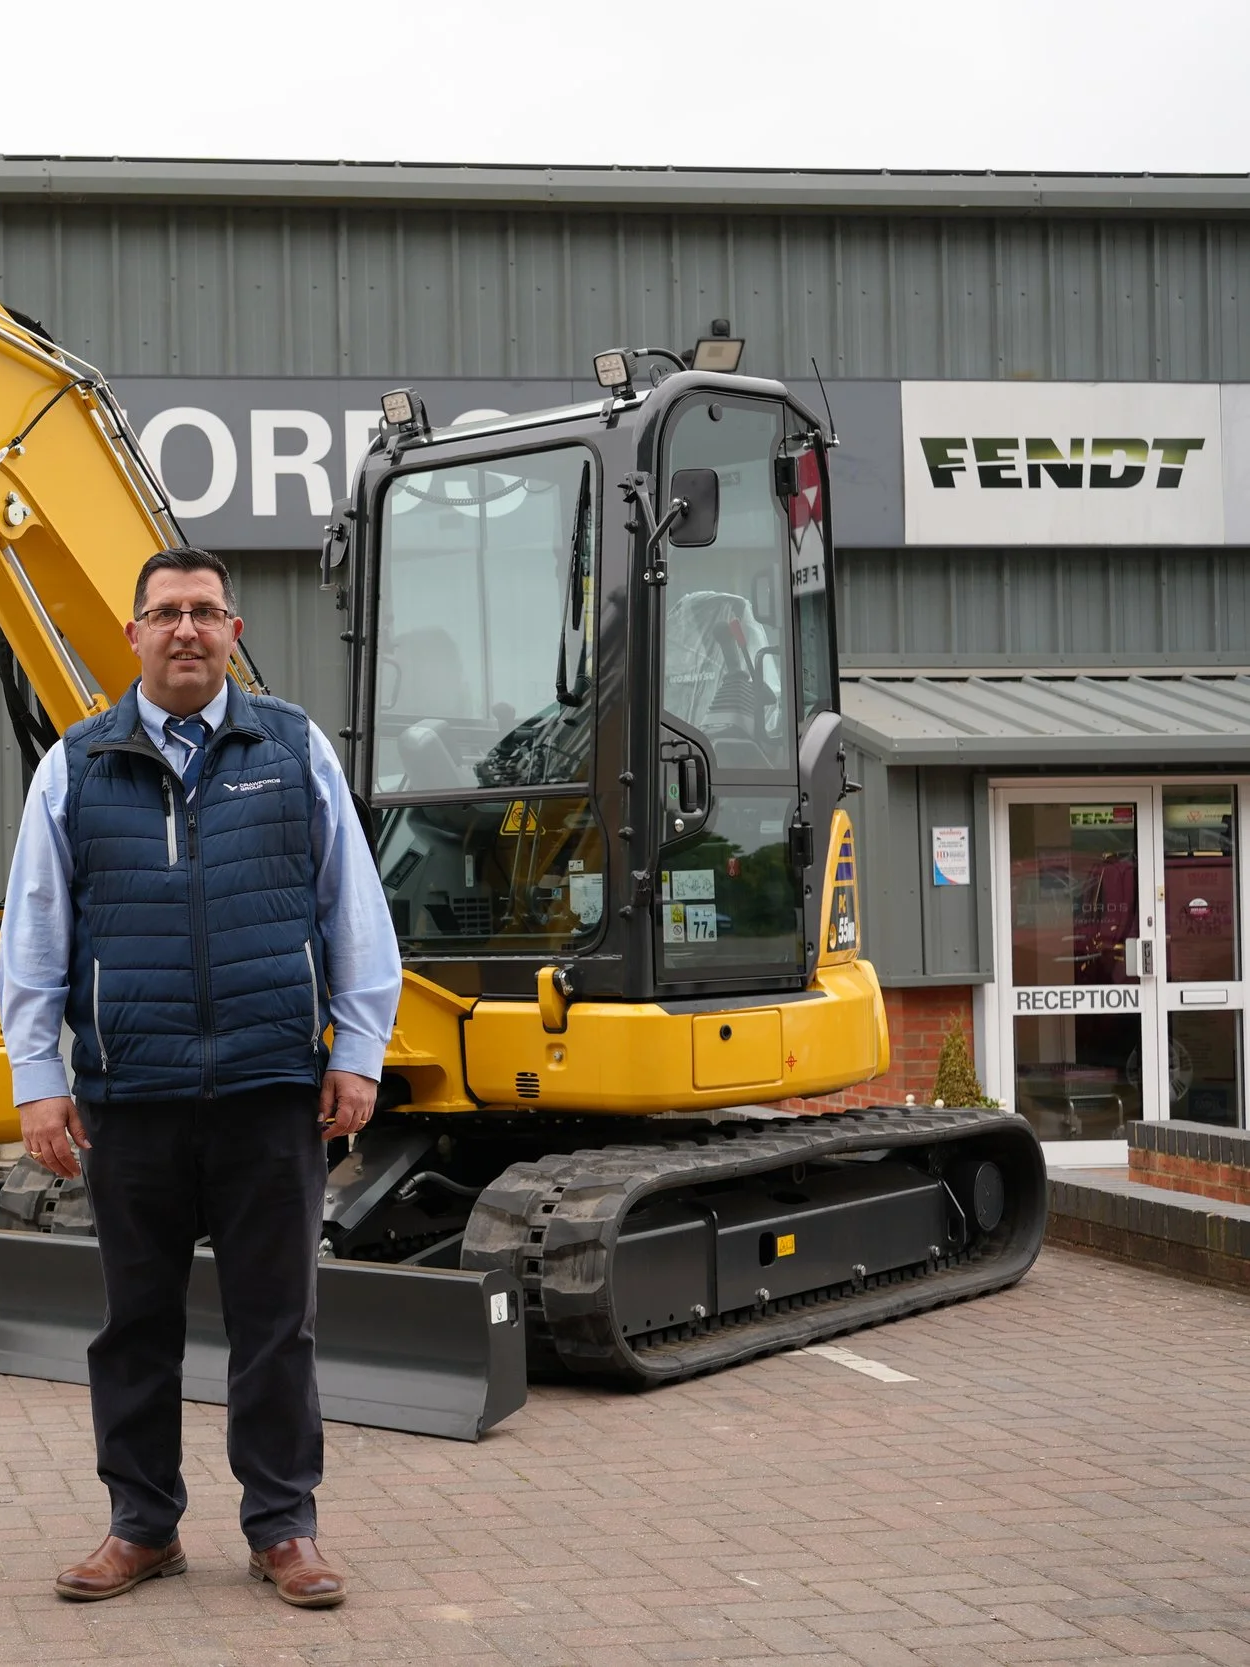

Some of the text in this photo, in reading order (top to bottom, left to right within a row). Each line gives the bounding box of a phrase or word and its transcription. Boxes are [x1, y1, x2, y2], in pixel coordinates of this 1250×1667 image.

[919, 437, 1206, 488] FENDT
[693, 921, 708, 939] 77
[1016, 989, 1140, 1010] RECEPTION
